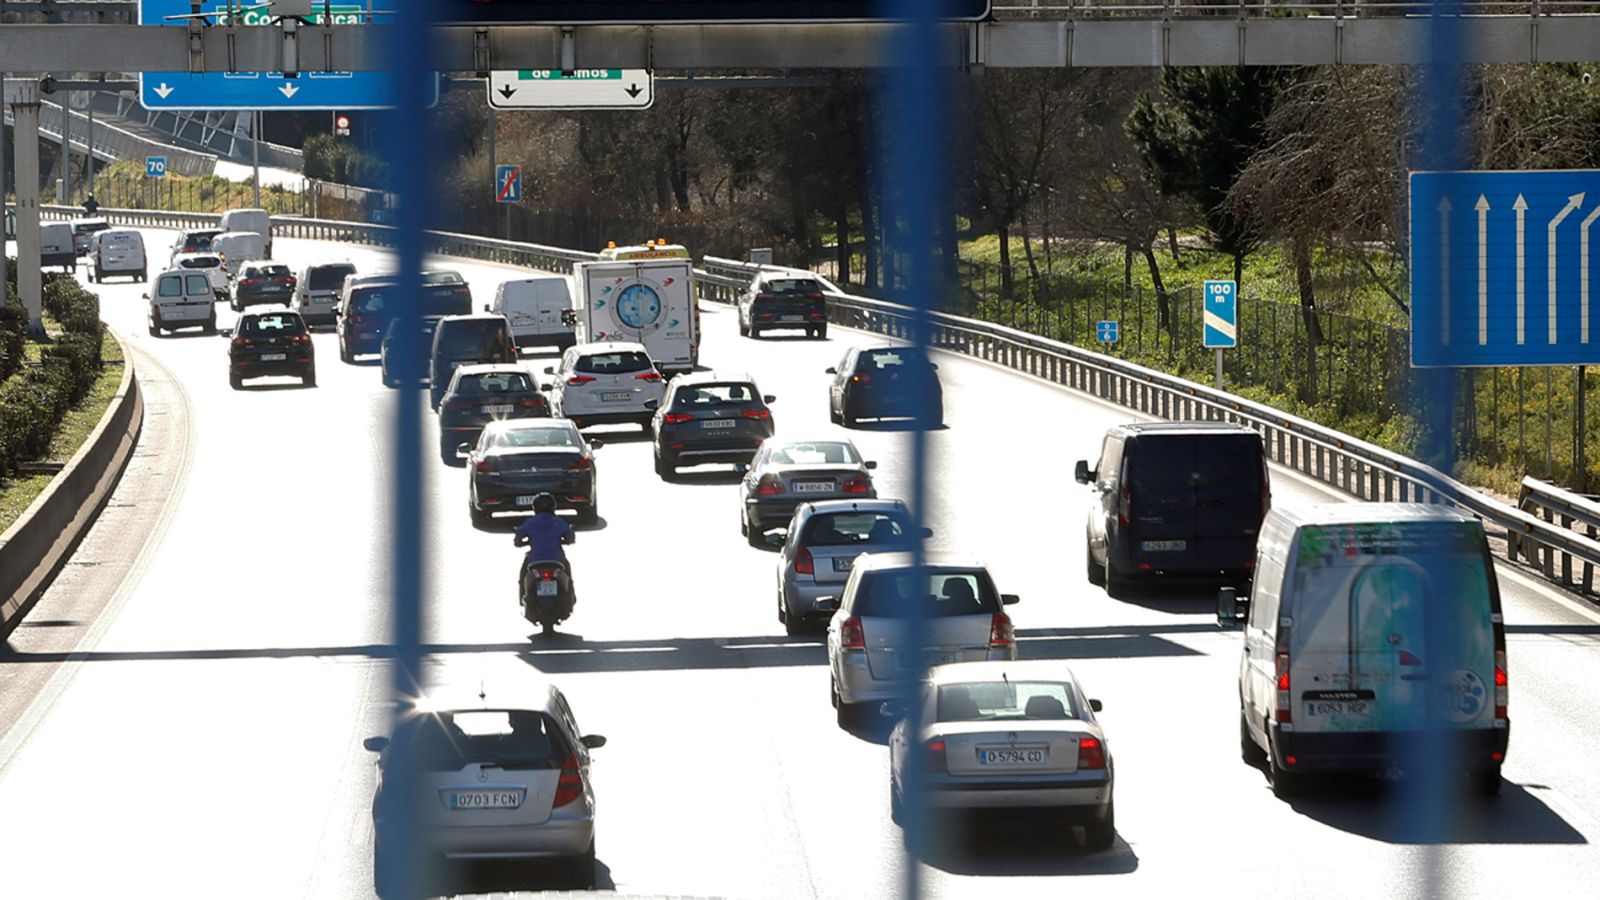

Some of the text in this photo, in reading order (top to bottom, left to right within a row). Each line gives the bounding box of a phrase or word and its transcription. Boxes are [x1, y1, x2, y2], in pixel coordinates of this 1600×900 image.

[149, 162, 164, 172] 70
[629, 251, 677, 259] AMBULANCIA
[1209, 284, 1231, 294] 100
[1104, 331, 1111, 340] 6
[1317, 703, 1342, 714] 6053
[459, 792, 517, 806] 0703 FCN
